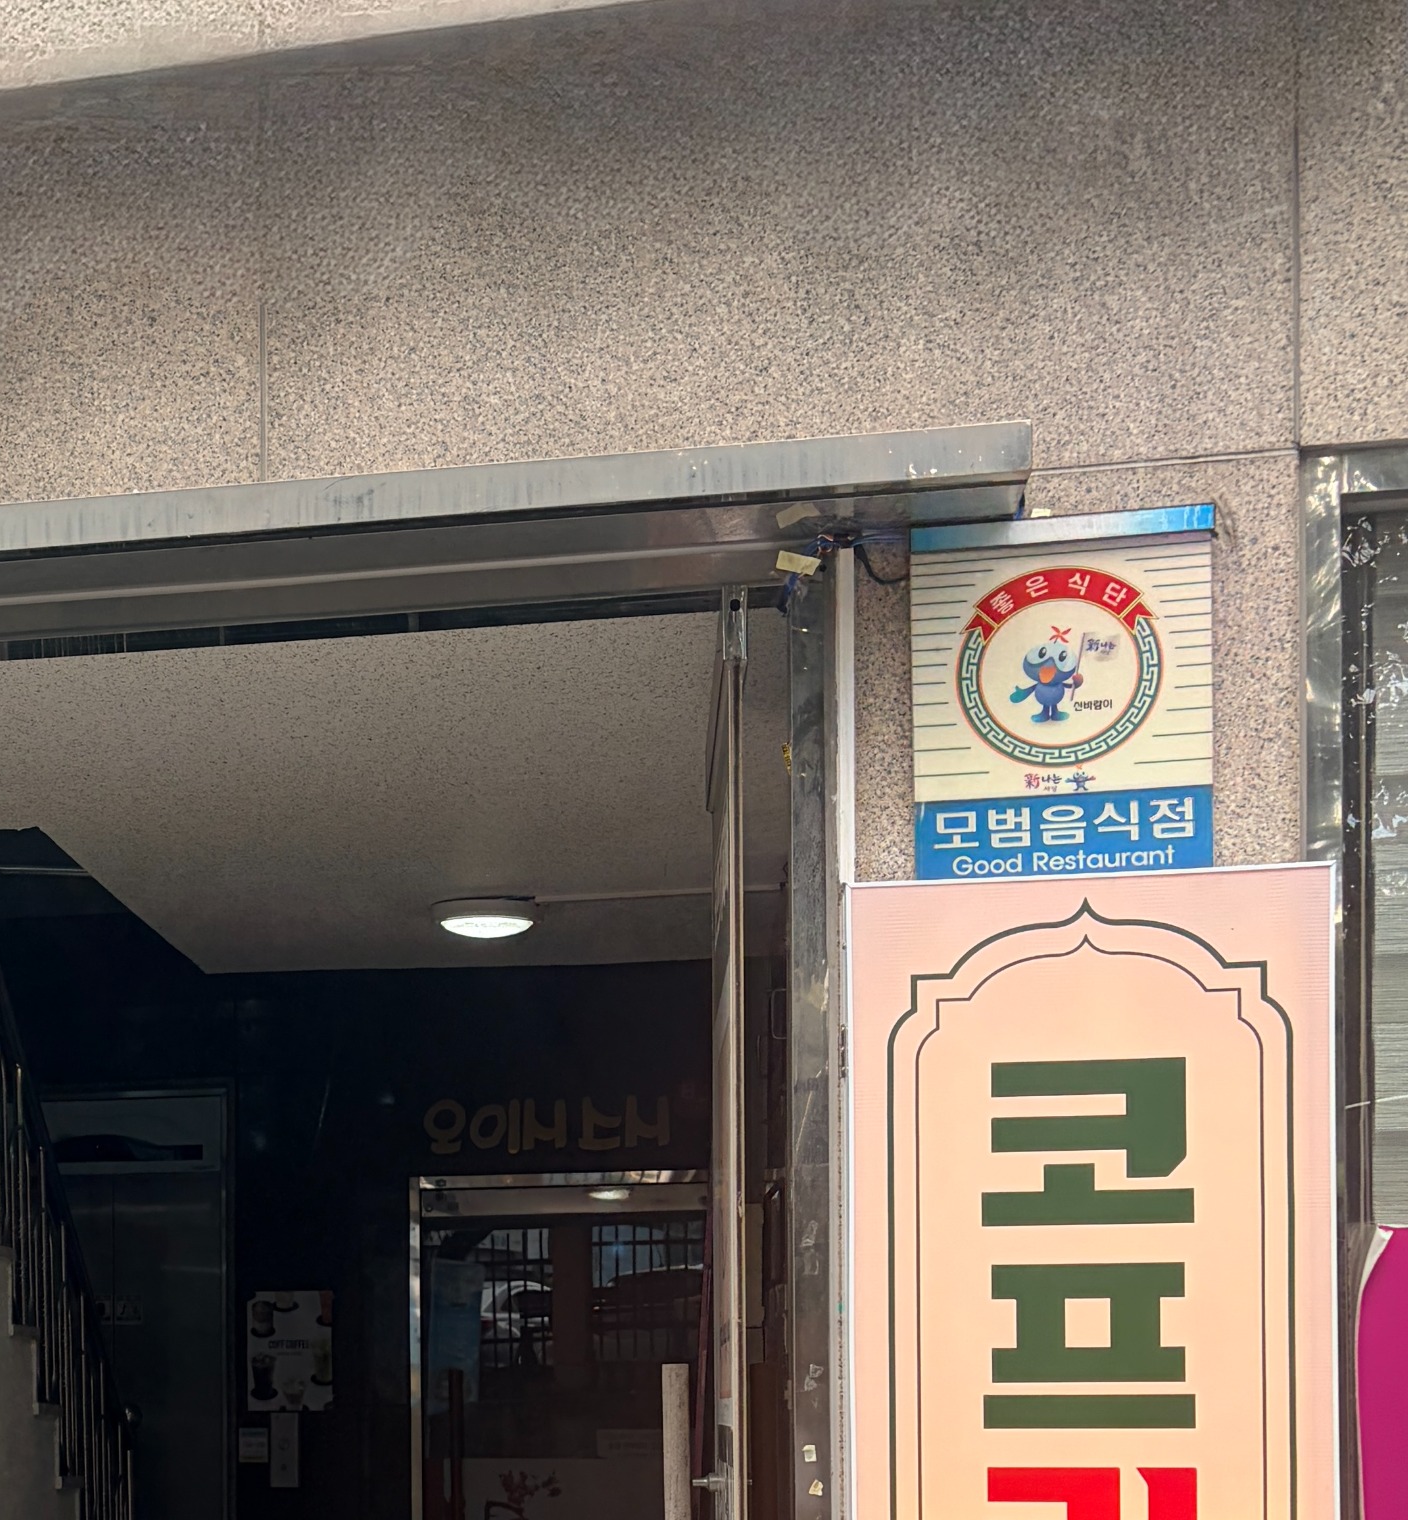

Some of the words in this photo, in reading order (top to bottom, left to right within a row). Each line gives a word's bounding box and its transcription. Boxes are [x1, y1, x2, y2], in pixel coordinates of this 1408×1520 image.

[990, 575, 1049, 615] 좋은
[1067, 572, 1128, 607] 식단
[1073, 698, 1113, 712] 신바람이
[933, 796, 1196, 849] 모범음식점
[952, 855, 1023, 877] Good
[1032, 844, 1176, 872] Restaurant
